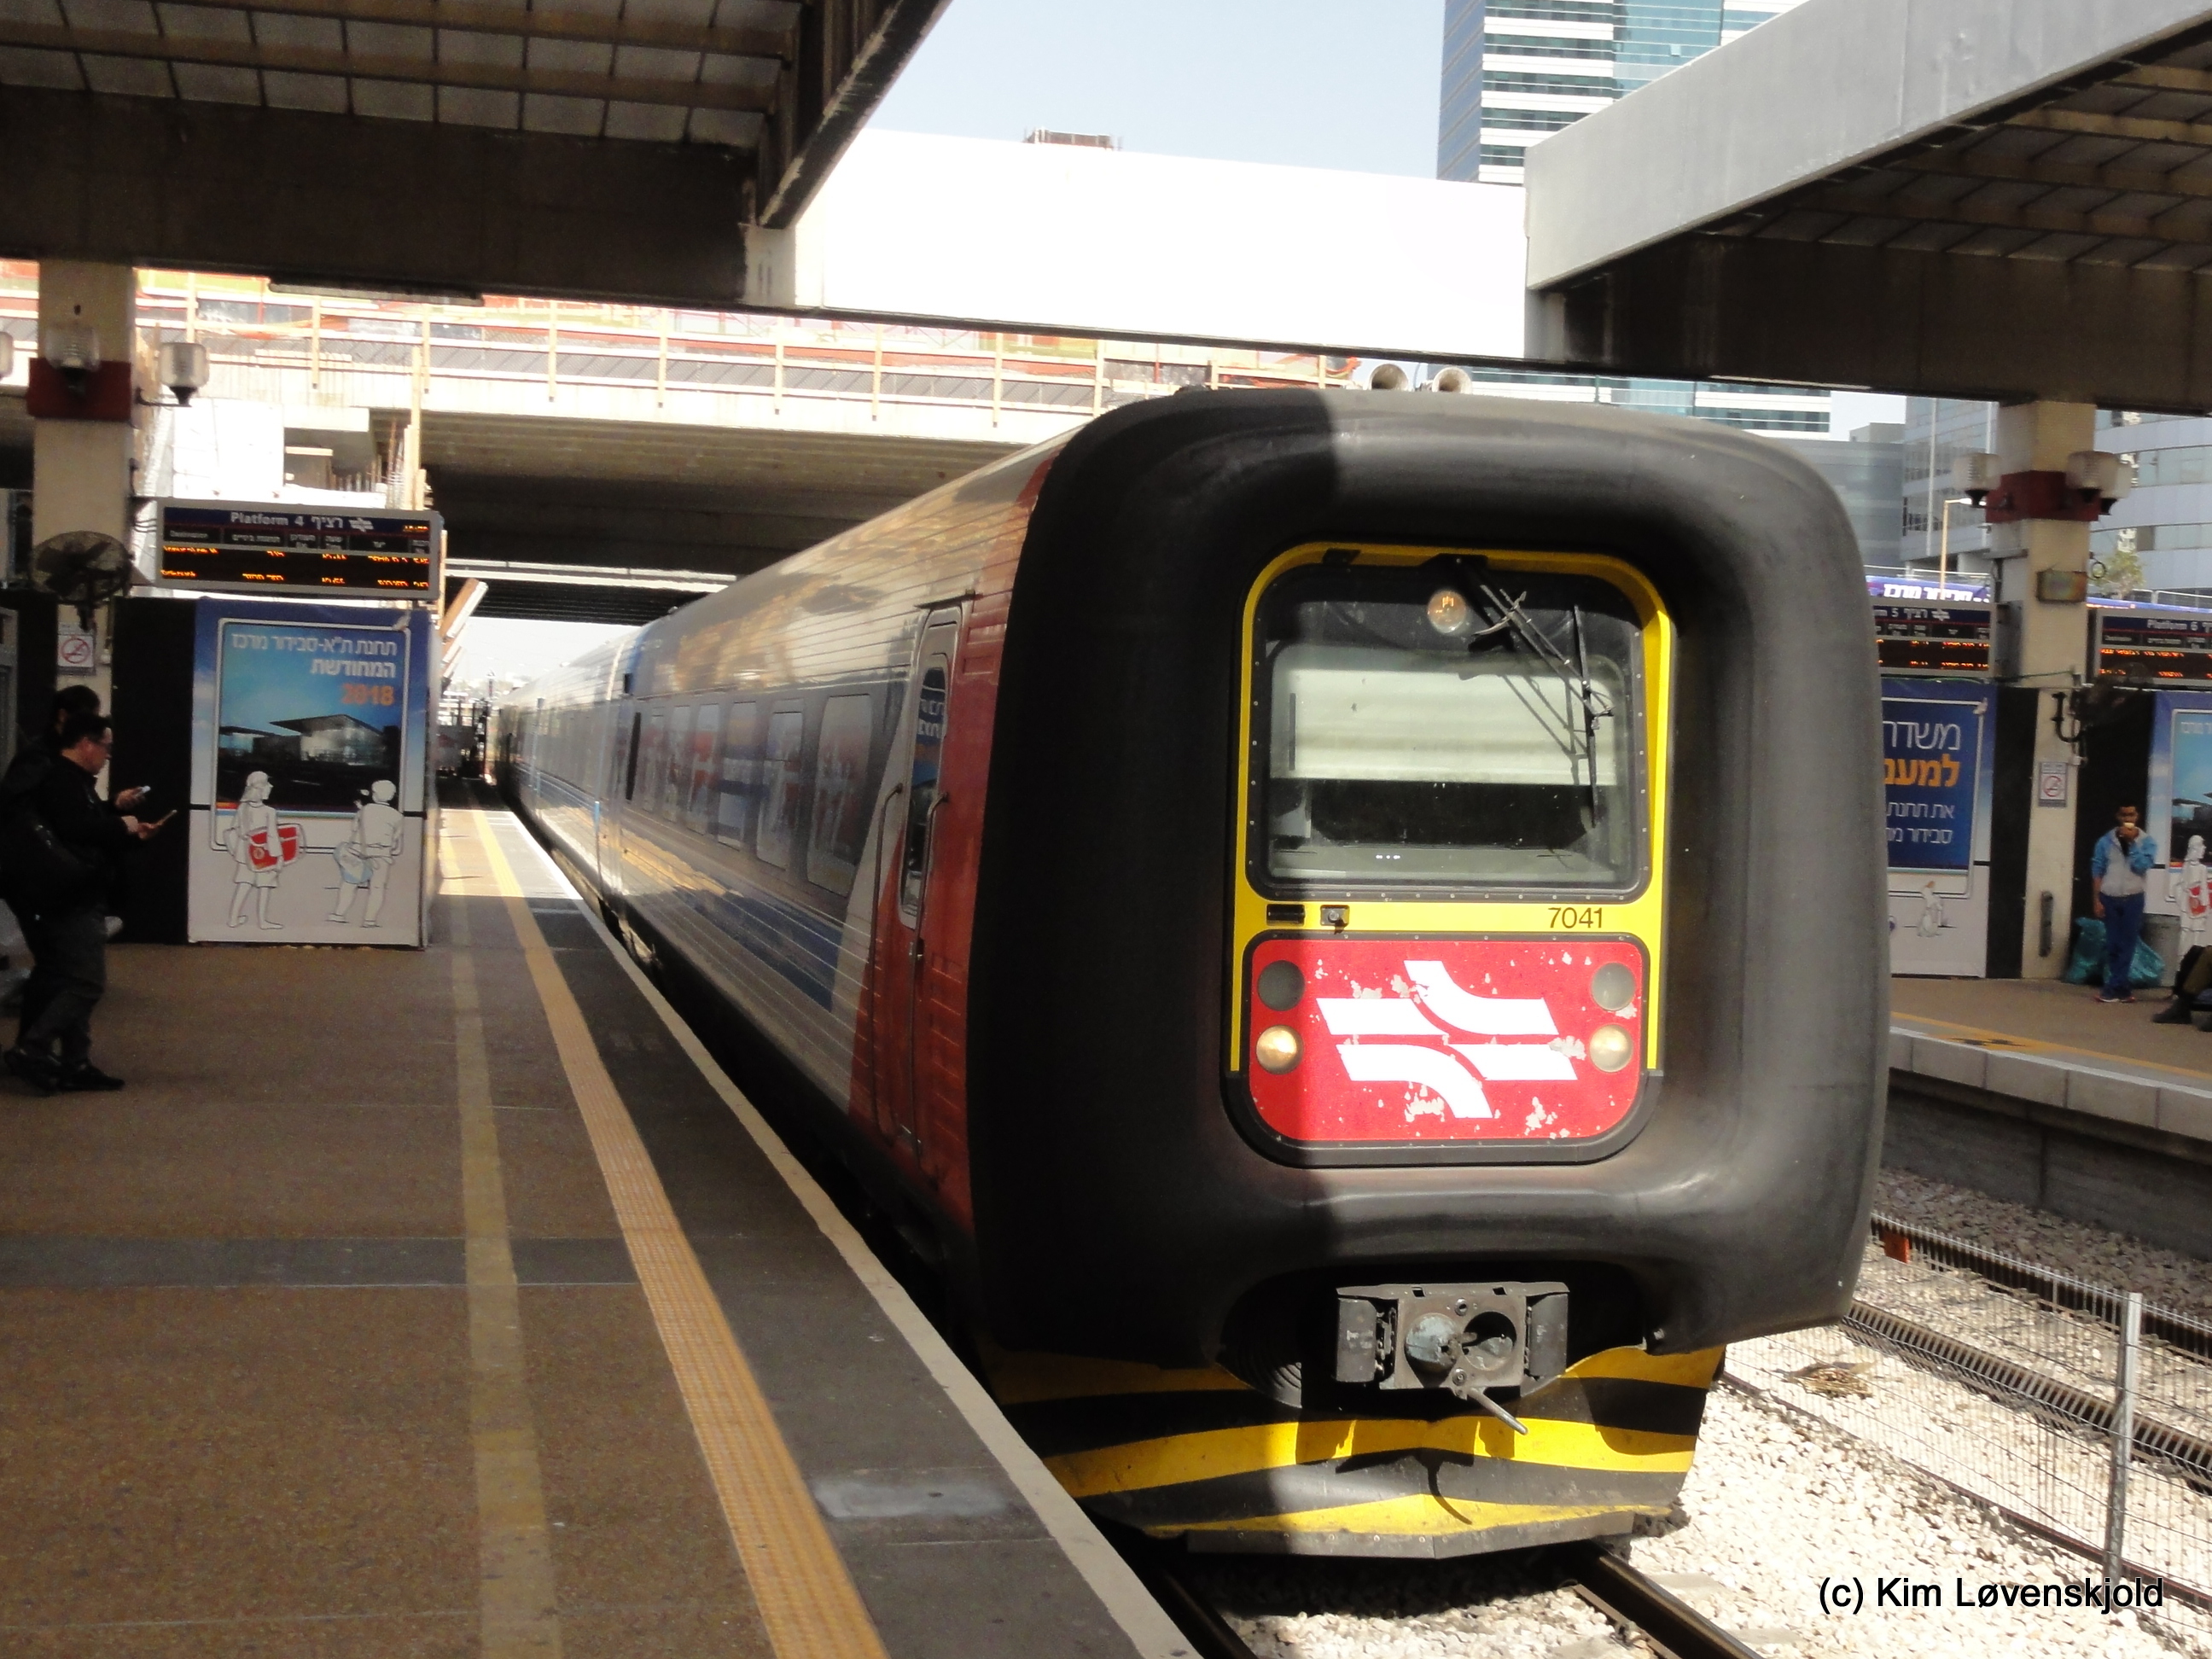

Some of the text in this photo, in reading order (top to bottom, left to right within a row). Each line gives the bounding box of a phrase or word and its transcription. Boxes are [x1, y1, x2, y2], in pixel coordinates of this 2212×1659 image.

[230, 512, 304, 527] Platform 4
[311, 516, 343, 530] רציף
[231, 633, 268, 650] מרכז
[310, 659, 397, 678] המחודשת
[343, 684, 394, 706] 2018
[1931, 804, 1955, 818] את
[1547, 907, 1603, 928] 7041
